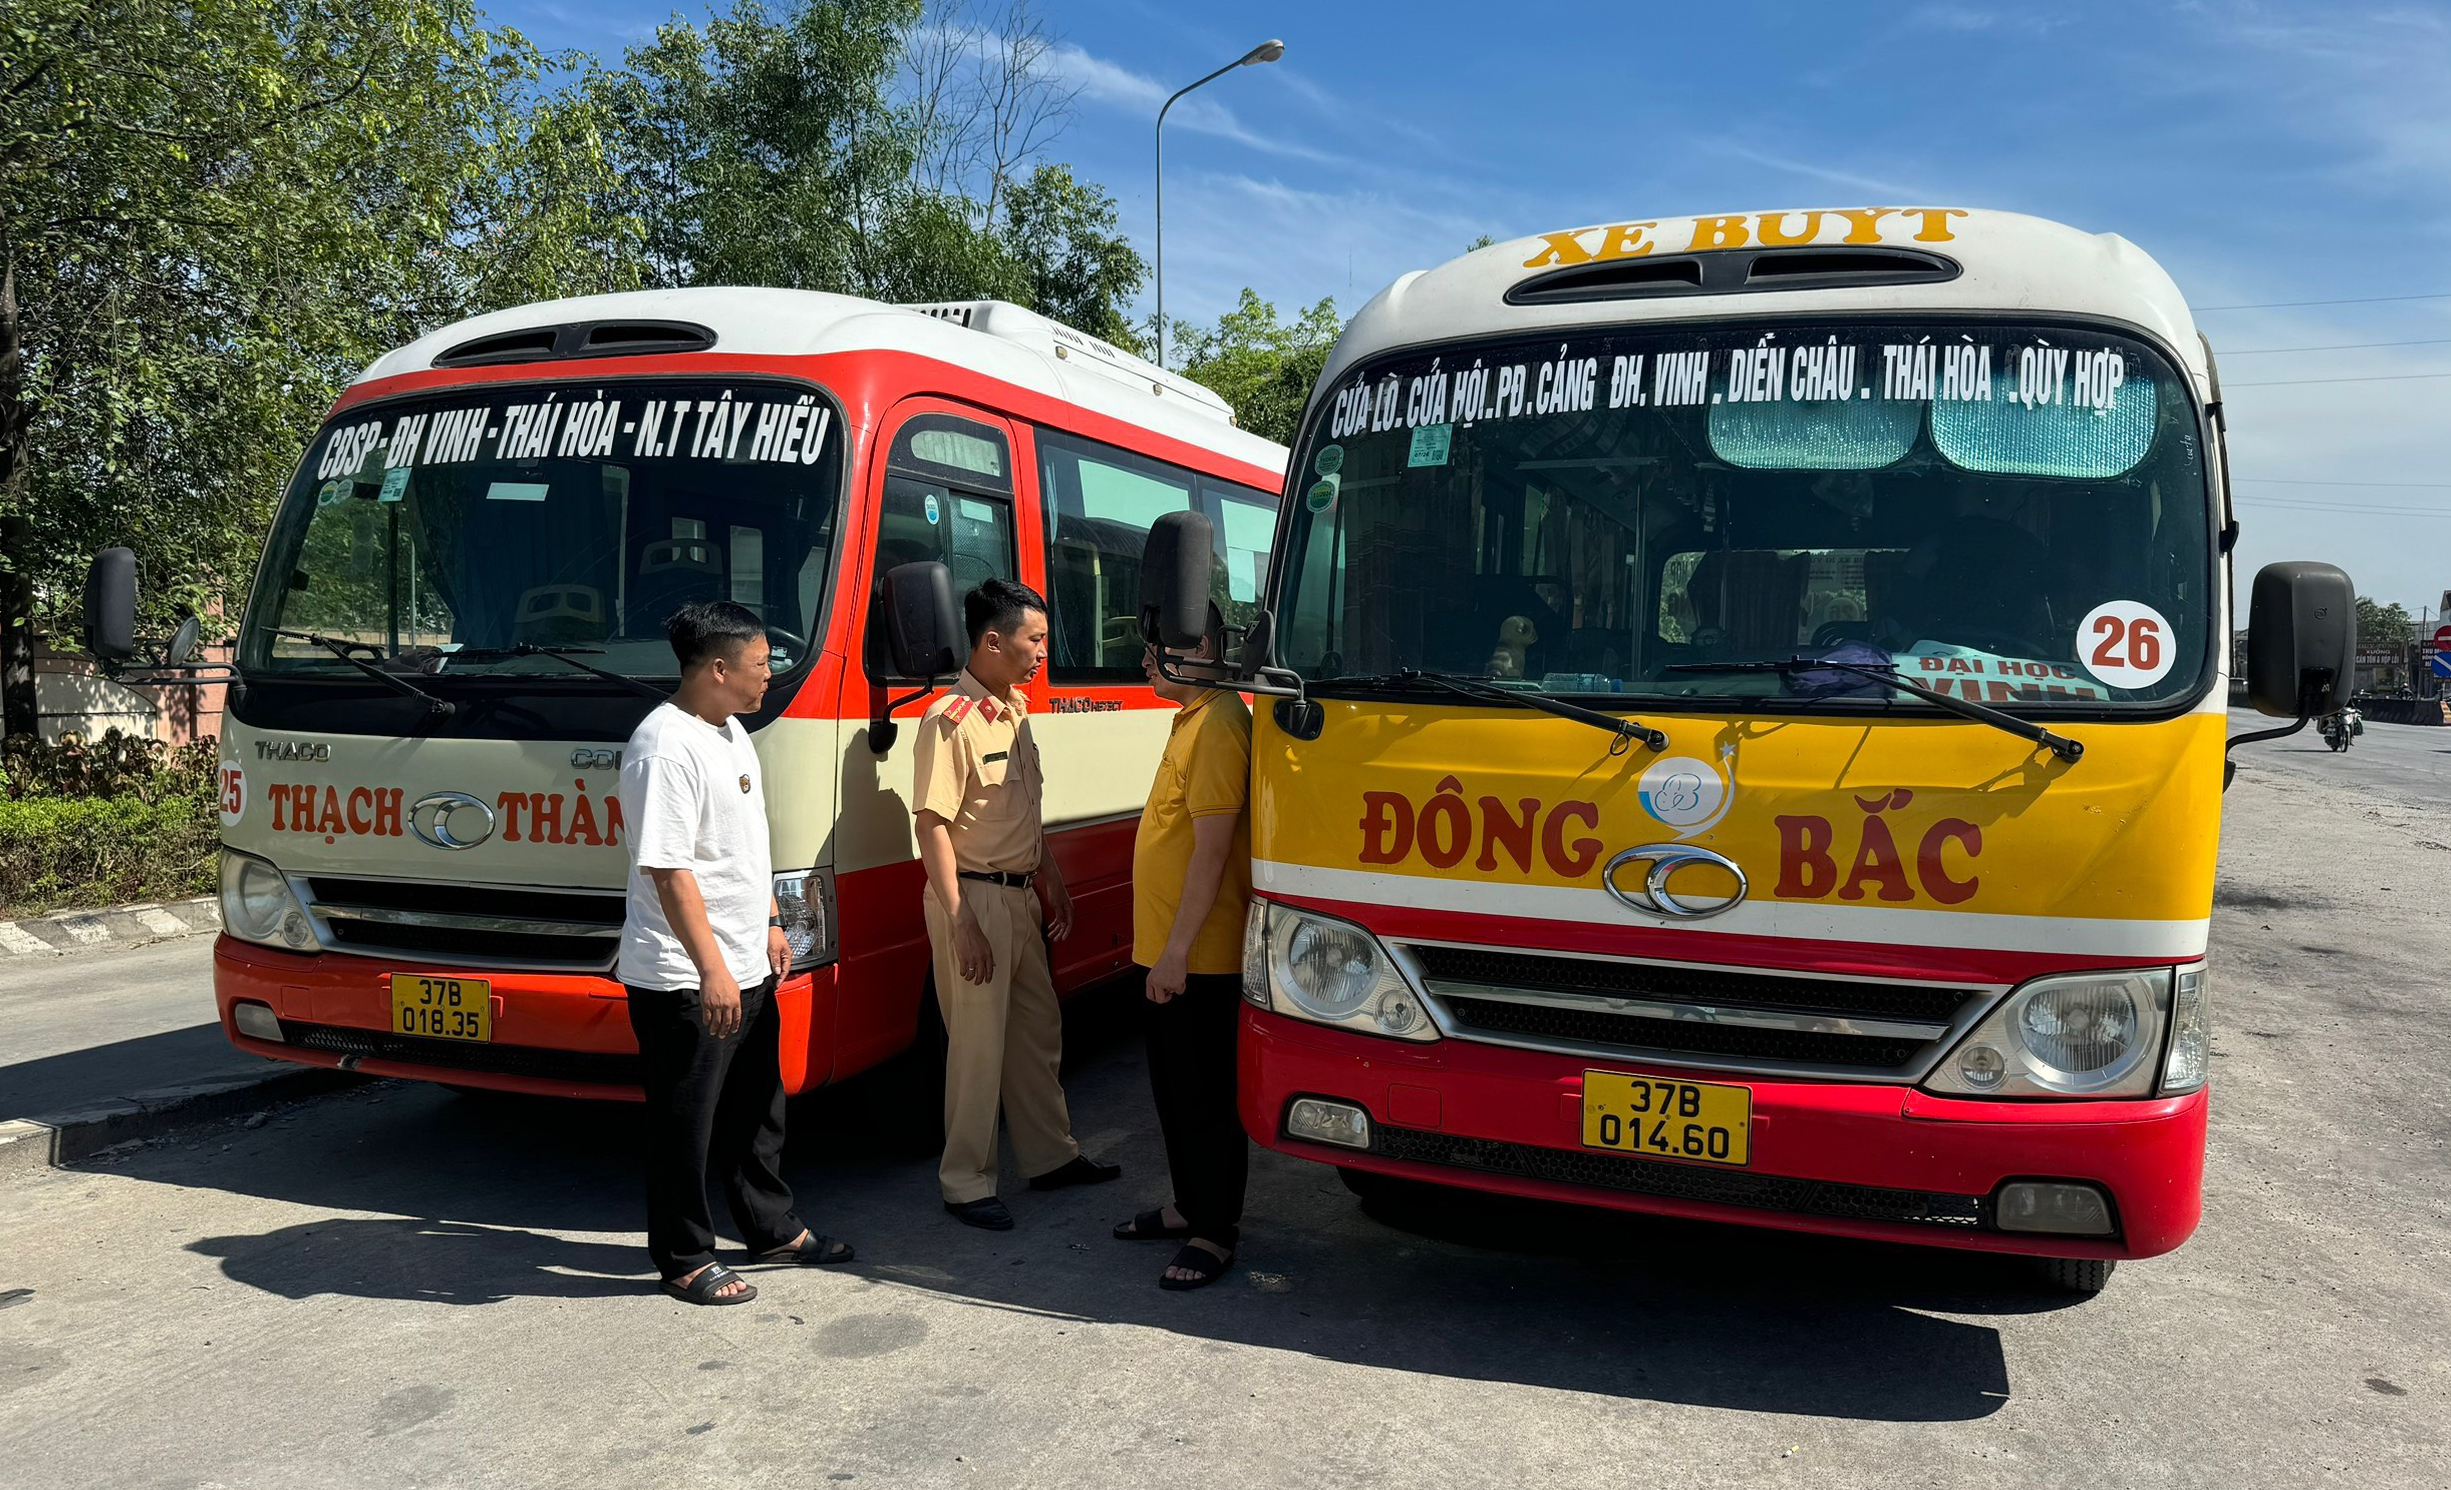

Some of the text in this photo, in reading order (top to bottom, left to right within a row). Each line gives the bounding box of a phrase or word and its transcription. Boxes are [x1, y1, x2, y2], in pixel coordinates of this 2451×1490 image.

[1522, 222, 1657, 268] XE
[1331, 370, 1371, 439] CỬA
[1406, 356, 1448, 429] CỬA
[1535, 343, 1598, 416] CẢNG
[1653, 351, 1710, 407] VINH
[1728, 332, 1786, 402] DIỄN
[1790, 335, 1856, 401] CHÂU
[1883, 334, 1937, 400] THÁI
[1943, 333, 1992, 401] HÒA
[2074, 347, 2125, 416] HỢP
[422, 407, 491, 465] VINH
[495, 392, 563, 460] THÁI
[557, 389, 621, 457] HÒA
[633, 400, 692, 457] N.T
[690, 389, 754, 459] TÂY
[749, 394, 831, 465] HIẾU
[2091, 615, 2160, 671] 26
[1918, 656, 2078, 681] ĐẠI HỌC
[255, 741, 331, 762] THACO
[220, 767, 242, 815] 25
[268, 778, 625, 847] THẠCH THÀN
[1358, 774, 1983, 906] ĐÔNG BẮC
[419, 979, 462, 1007] 37B
[402, 1007, 479, 1038] 018.35
[1629, 1080, 1700, 1118] 37B
[1600, 1113, 1730, 1159] 014.60
